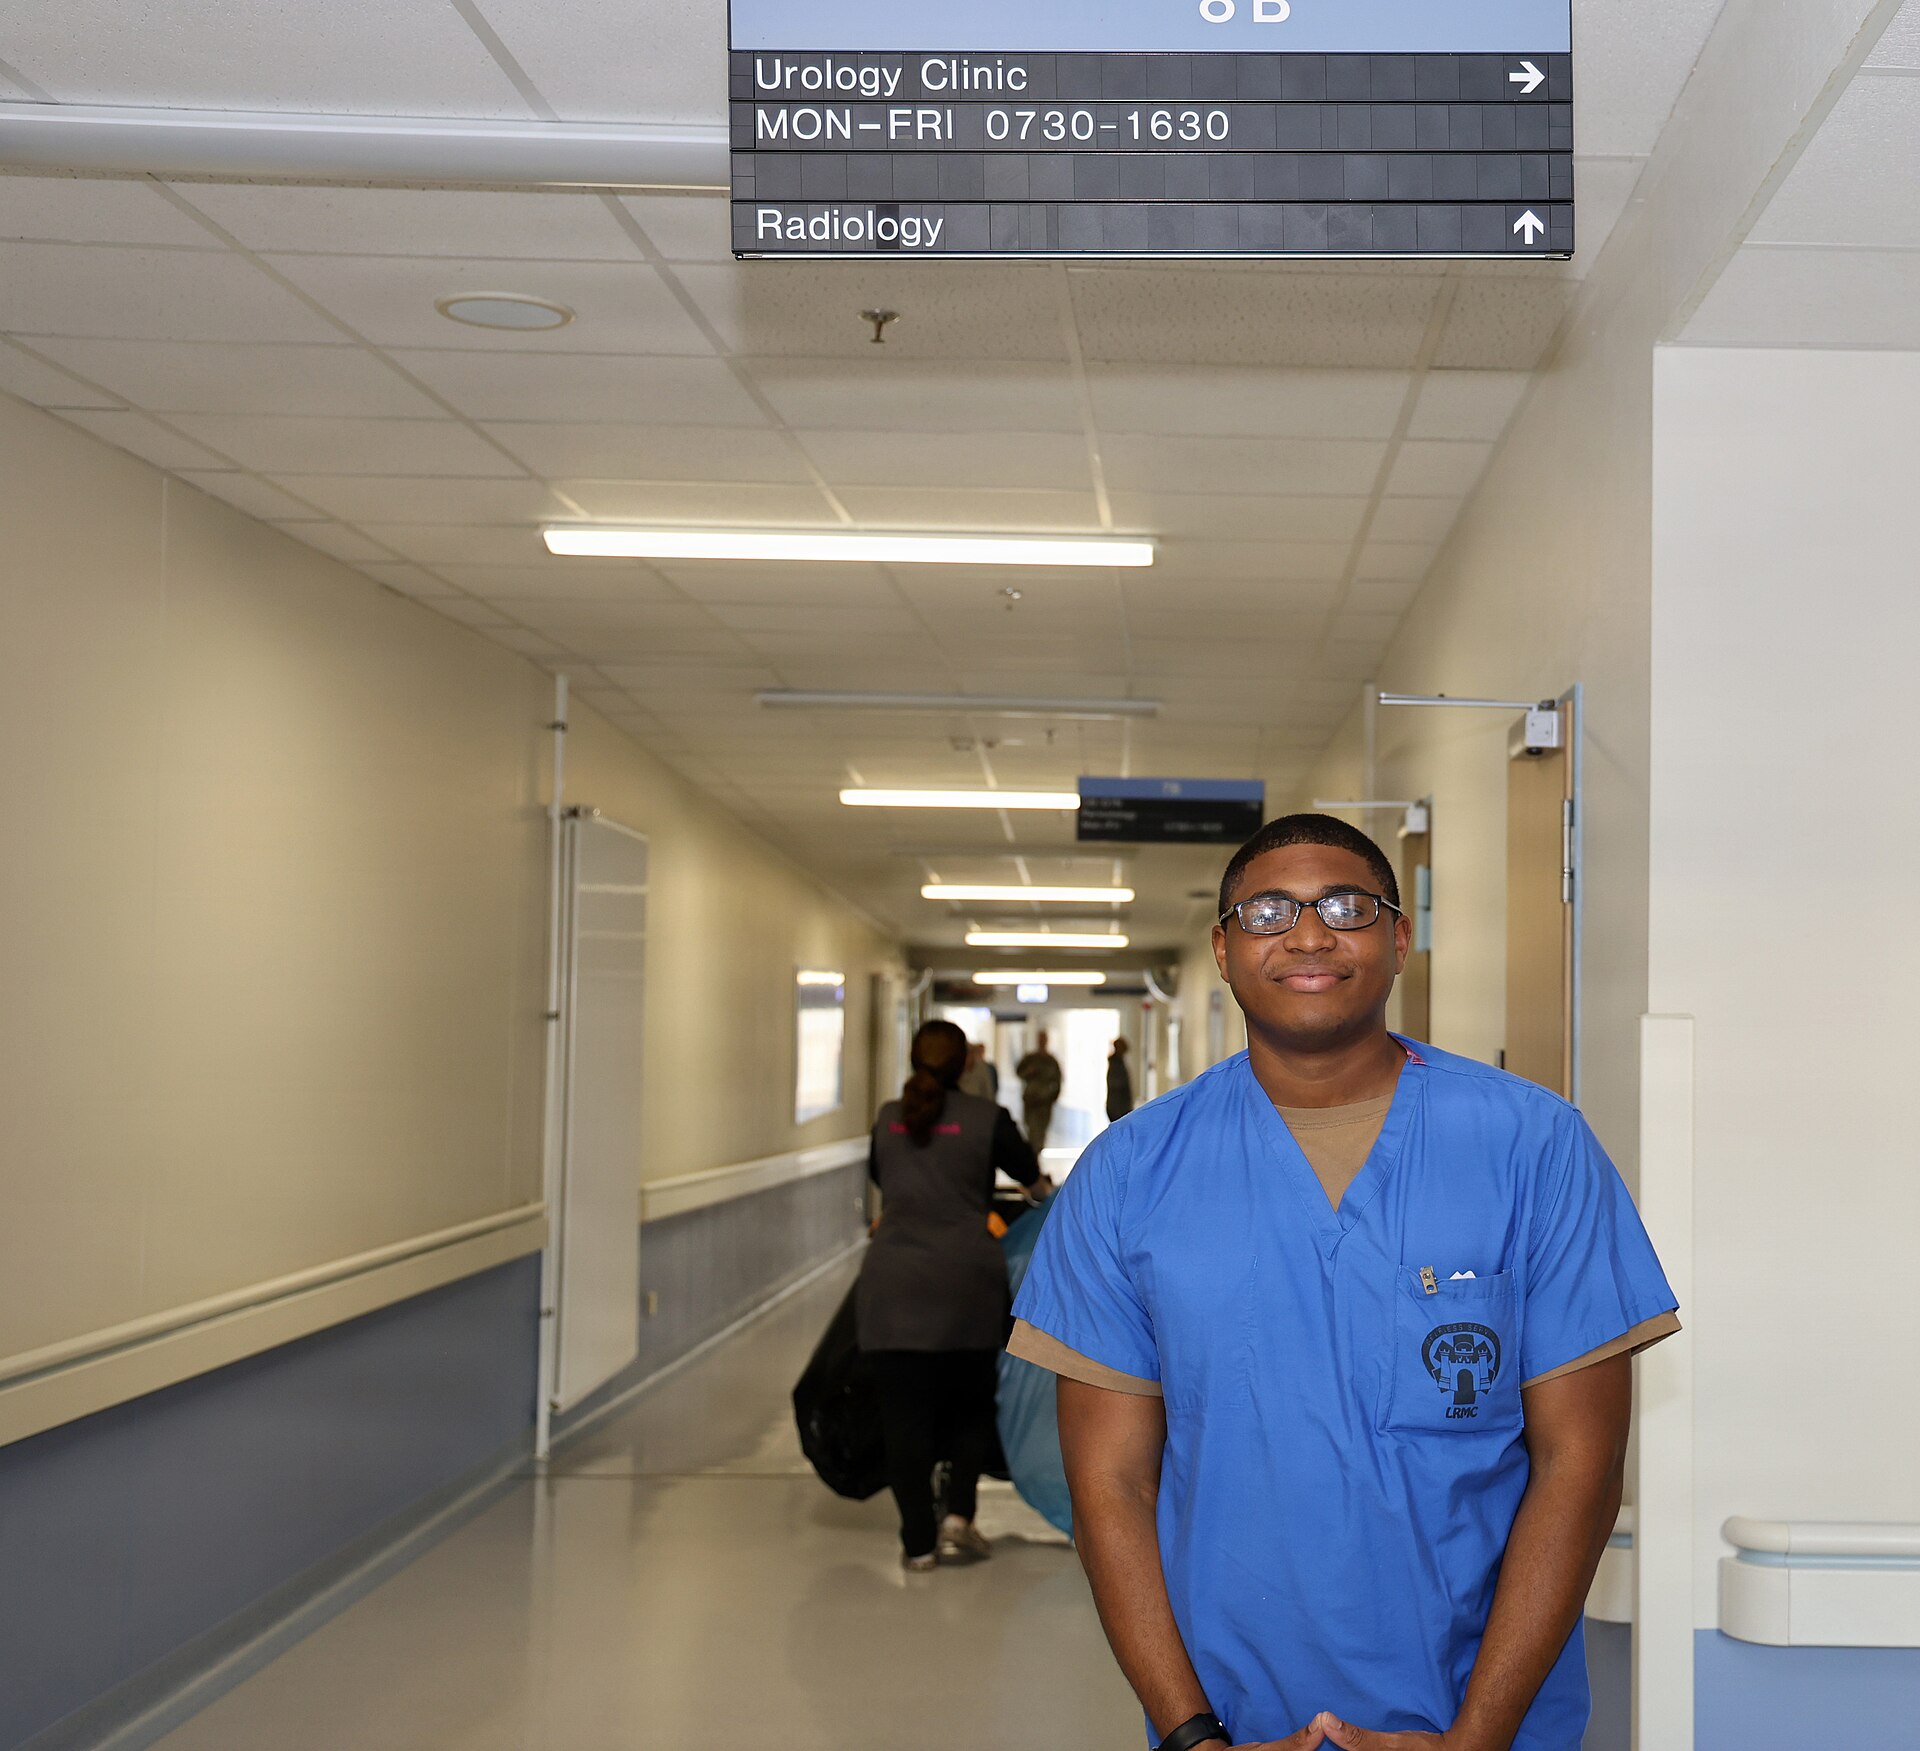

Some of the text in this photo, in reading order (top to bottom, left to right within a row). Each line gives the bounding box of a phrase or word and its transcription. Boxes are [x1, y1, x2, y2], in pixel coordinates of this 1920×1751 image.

[757, 59, 1027, 97] Urology Clinic
[986, 110, 1229, 140] 0730-1630
[758, 210, 944, 247] Radiology
[1445, 1406, 1478, 1419] LRMC
